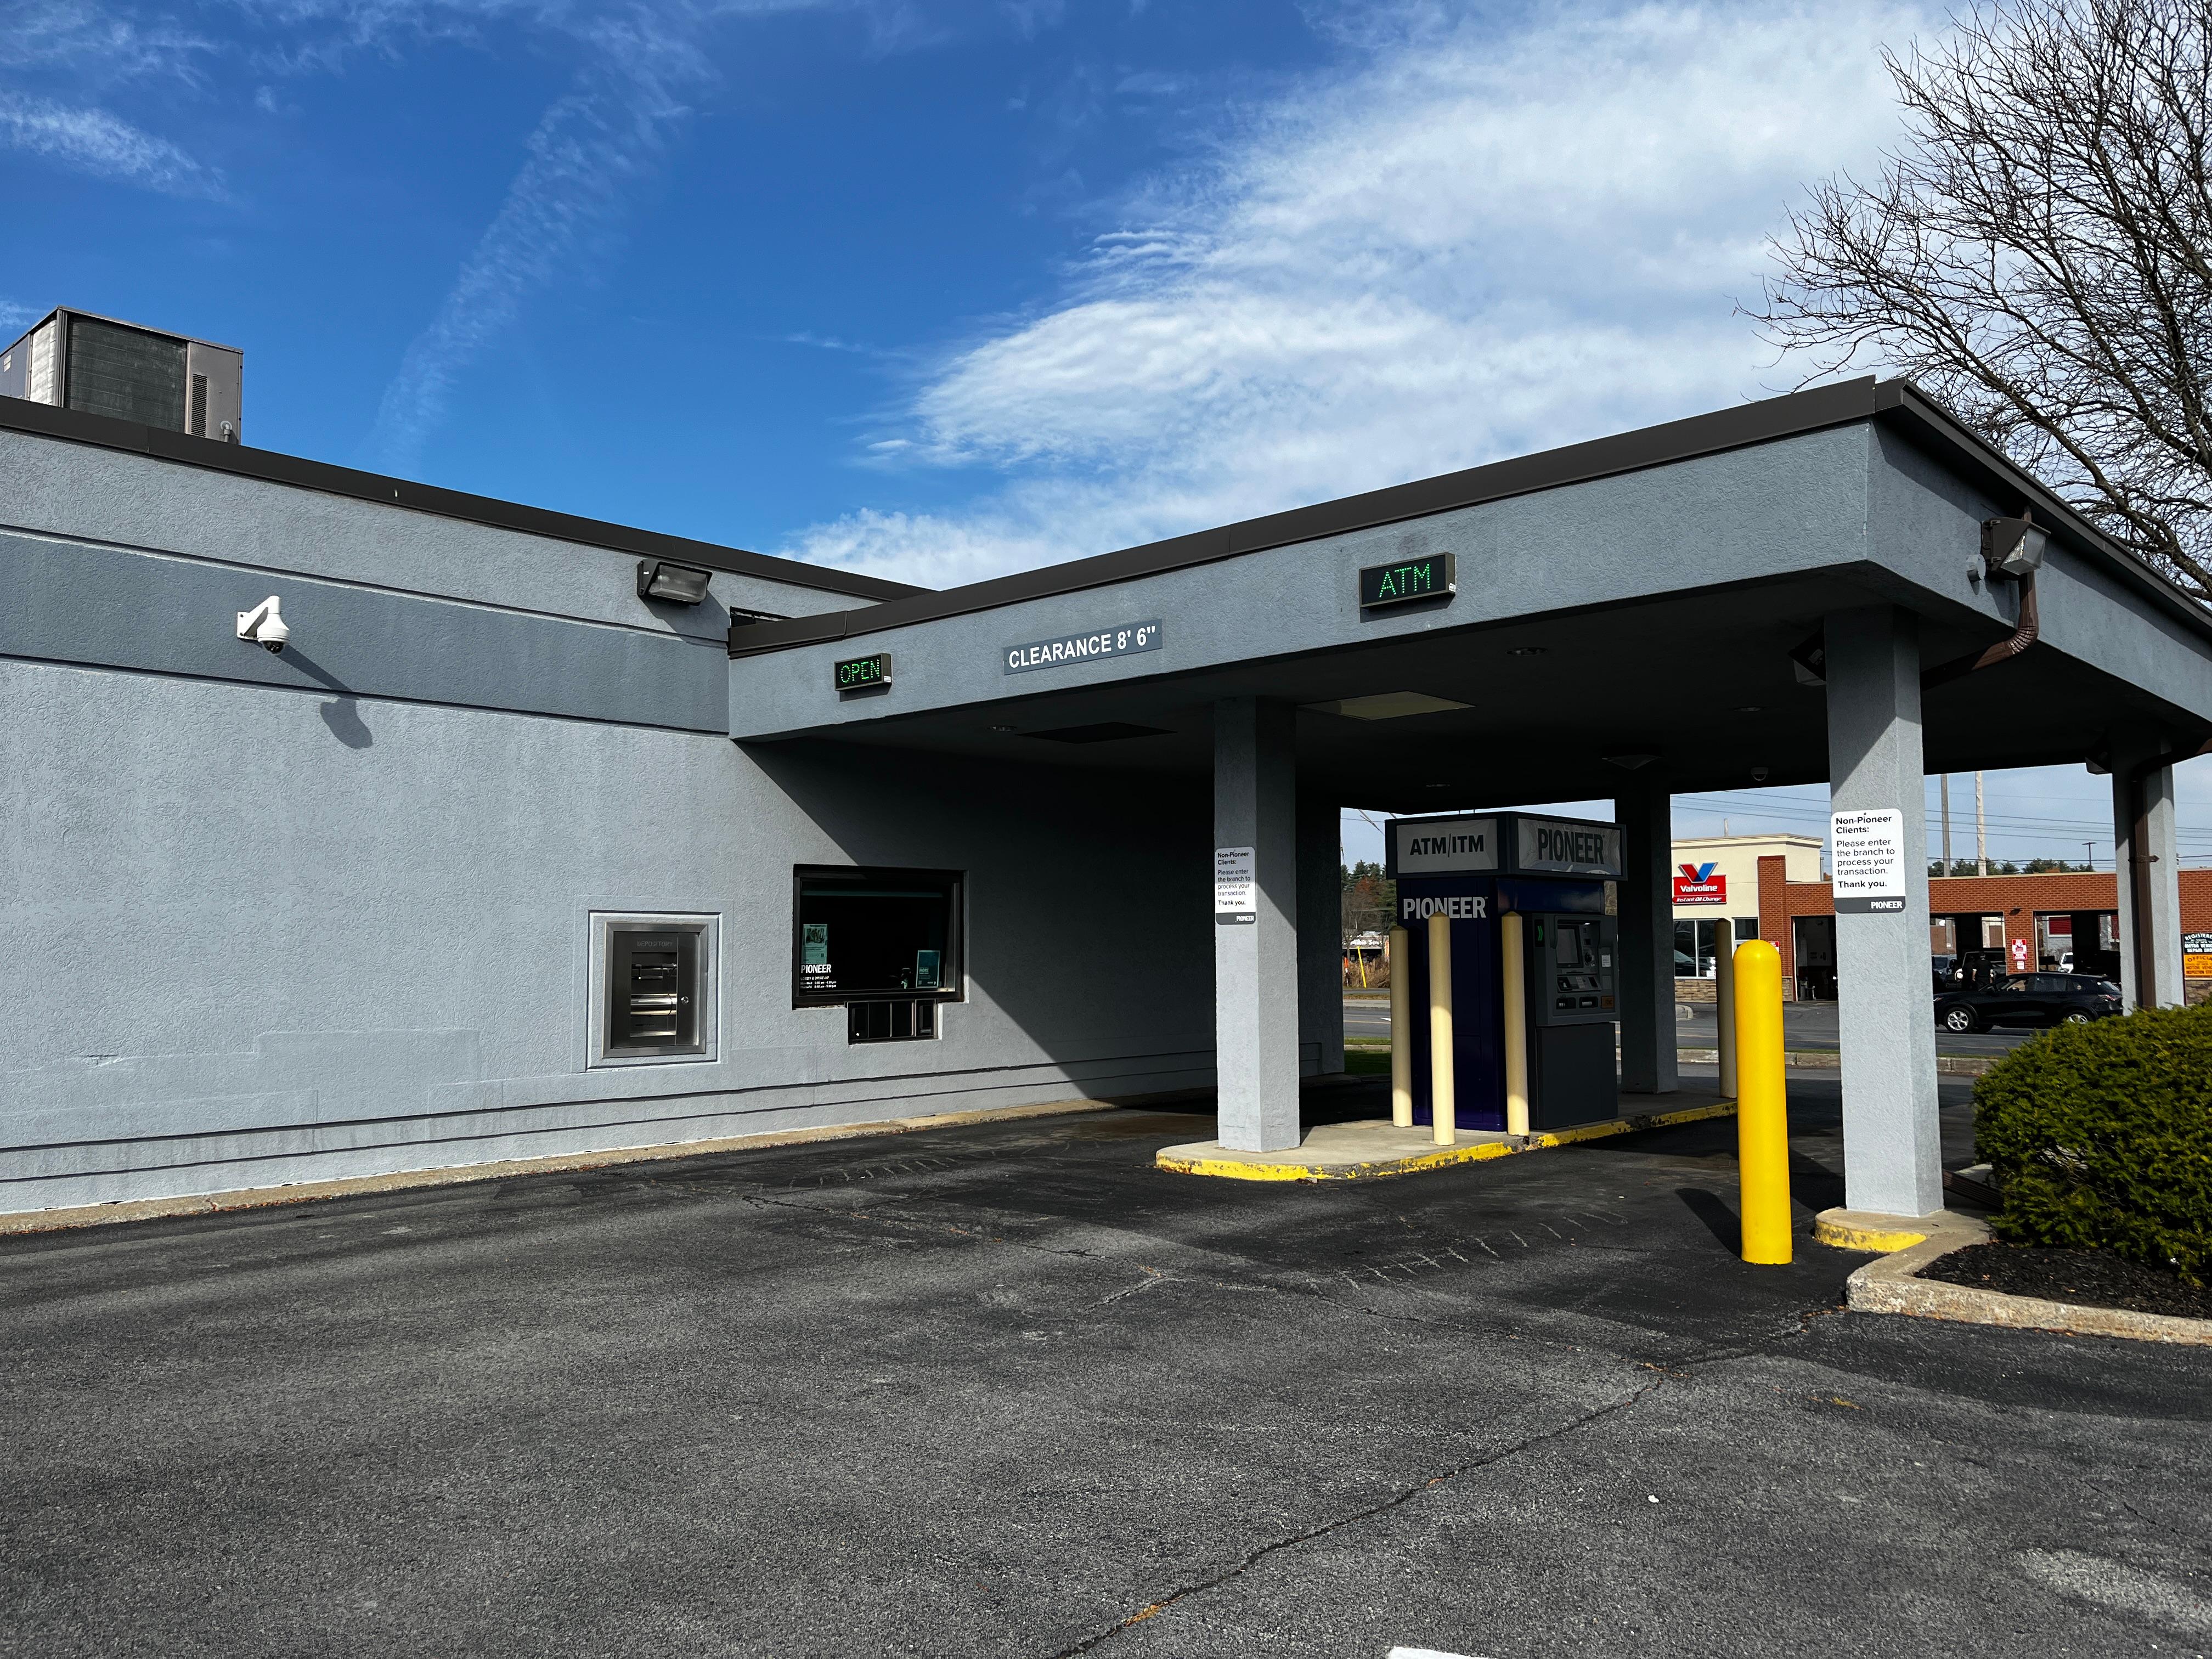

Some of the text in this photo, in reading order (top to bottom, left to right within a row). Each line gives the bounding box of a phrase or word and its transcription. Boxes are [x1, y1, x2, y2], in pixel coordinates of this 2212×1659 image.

[1379, 563, 1431, 598] ATM
[1009, 625, 1155, 668] CLEARANCE 8' 6"
[840, 659, 880, 684] OPEN
[1836, 816, 1892, 825] Non-Pioneer
[1409, 833, 1485, 858] ATM/ITM
[1538, 828, 1604, 865] PIONEER
[1853, 848, 1883, 856] branch
[1874, 858, 1894, 867] your
[1838, 867, 1888, 876] transaction.
[1680, 884, 1718, 893] Valvoline
[1403, 896, 1487, 919] PIONEER
[1871, 901, 1903, 909] PIONEER
[800, 964, 832, 974] PIONEER
